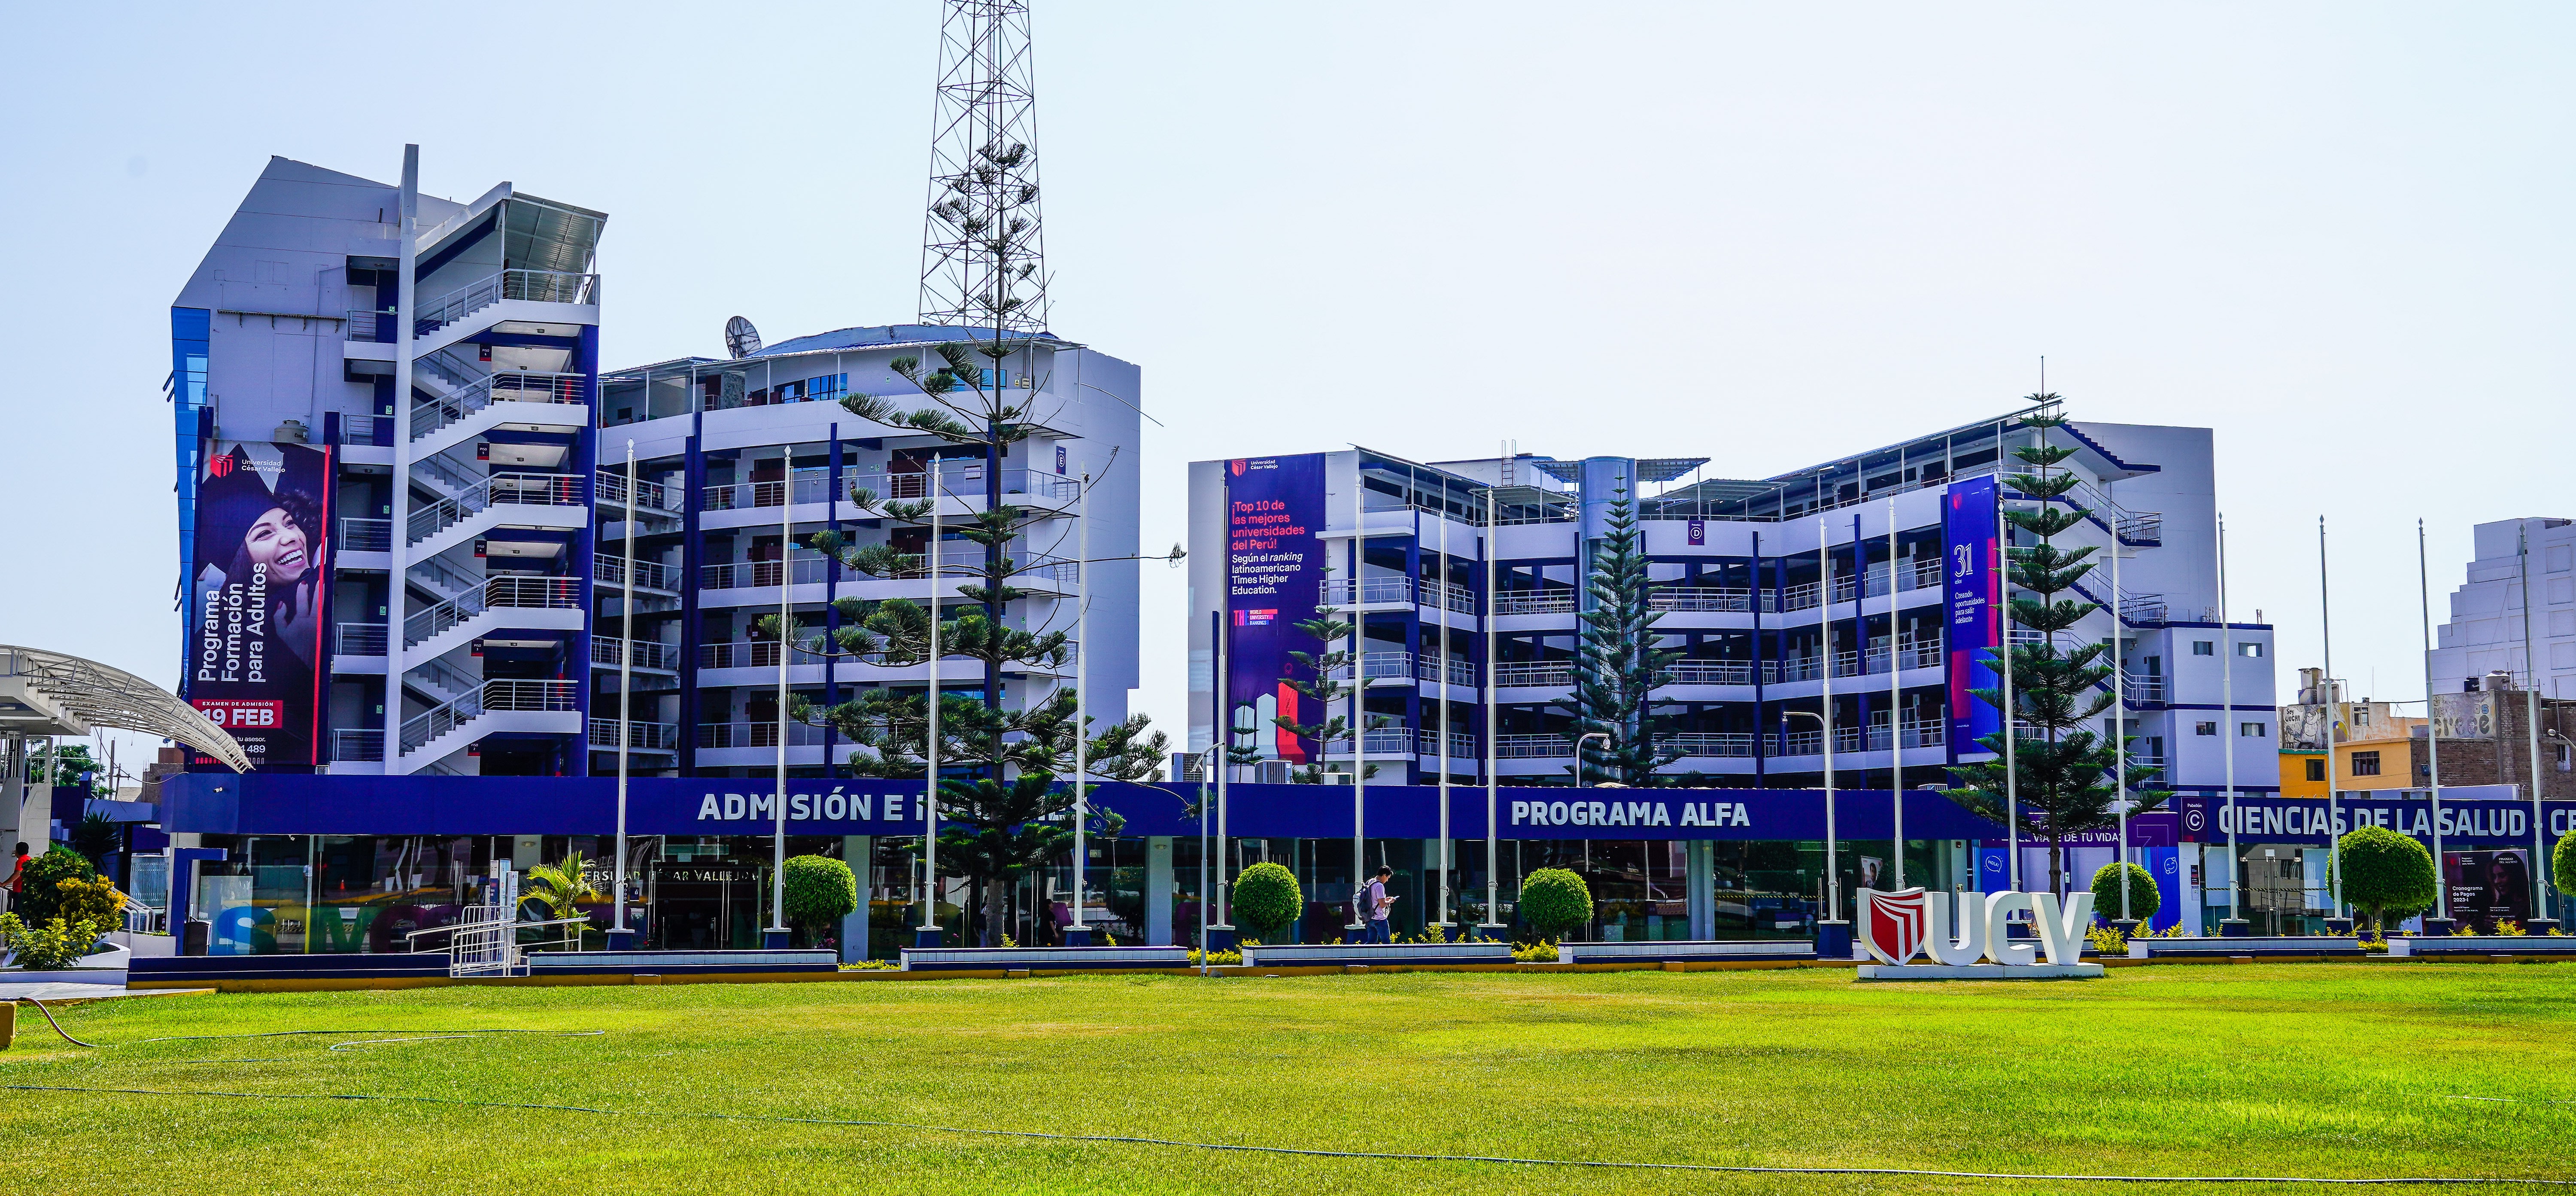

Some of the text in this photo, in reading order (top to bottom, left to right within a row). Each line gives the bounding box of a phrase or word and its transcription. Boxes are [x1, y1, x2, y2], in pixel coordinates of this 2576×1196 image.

[1060, 456, 1063, 465] E
[1232, 500, 1285, 514] ¡Top 10 de
[1232, 514, 1290, 526] las mejores
[1232, 526, 1305, 537] universidades
[1232, 537, 1277, 551] del Perú!
[1232, 552, 1303, 565] Según el ranking
[1954, 542, 1973, 577] 31
[1232, 563, 1301, 574] latinoamericano
[1232, 574, 1288, 587] Times Higher
[1232, 585, 1277, 595] Education.
[1955, 590, 1973, 600] Creando
[1955, 597, 1985, 608] oportunidades
[1234, 609, 1249, 626] THE
[1955, 609, 1965, 618] para
[1955, 616, 1973, 624] adelante
[246, 563, 267, 682] para Adultos
[198, 590, 222, 682] Programa
[221, 583, 243, 682] Formación
[202, 709, 274, 725] 19 FEB
[246, 745, 266, 753] 489
[884, 794, 903, 821] E
[1511, 801, 1751, 826] PROGRAMA ALFA
[2190, 814, 2199, 826] C
[2219, 805, 2347, 835] CIENCIAS
[2397, 808, 2432, 836] LA
[2439, 808, 2526, 837] SALUD
[2064, 833, 2078, 842] DE
[2081, 833, 2093, 842] TU
[2095, 832, 2122, 842] VIDA
[1925, 890, 2096, 966] UCV
